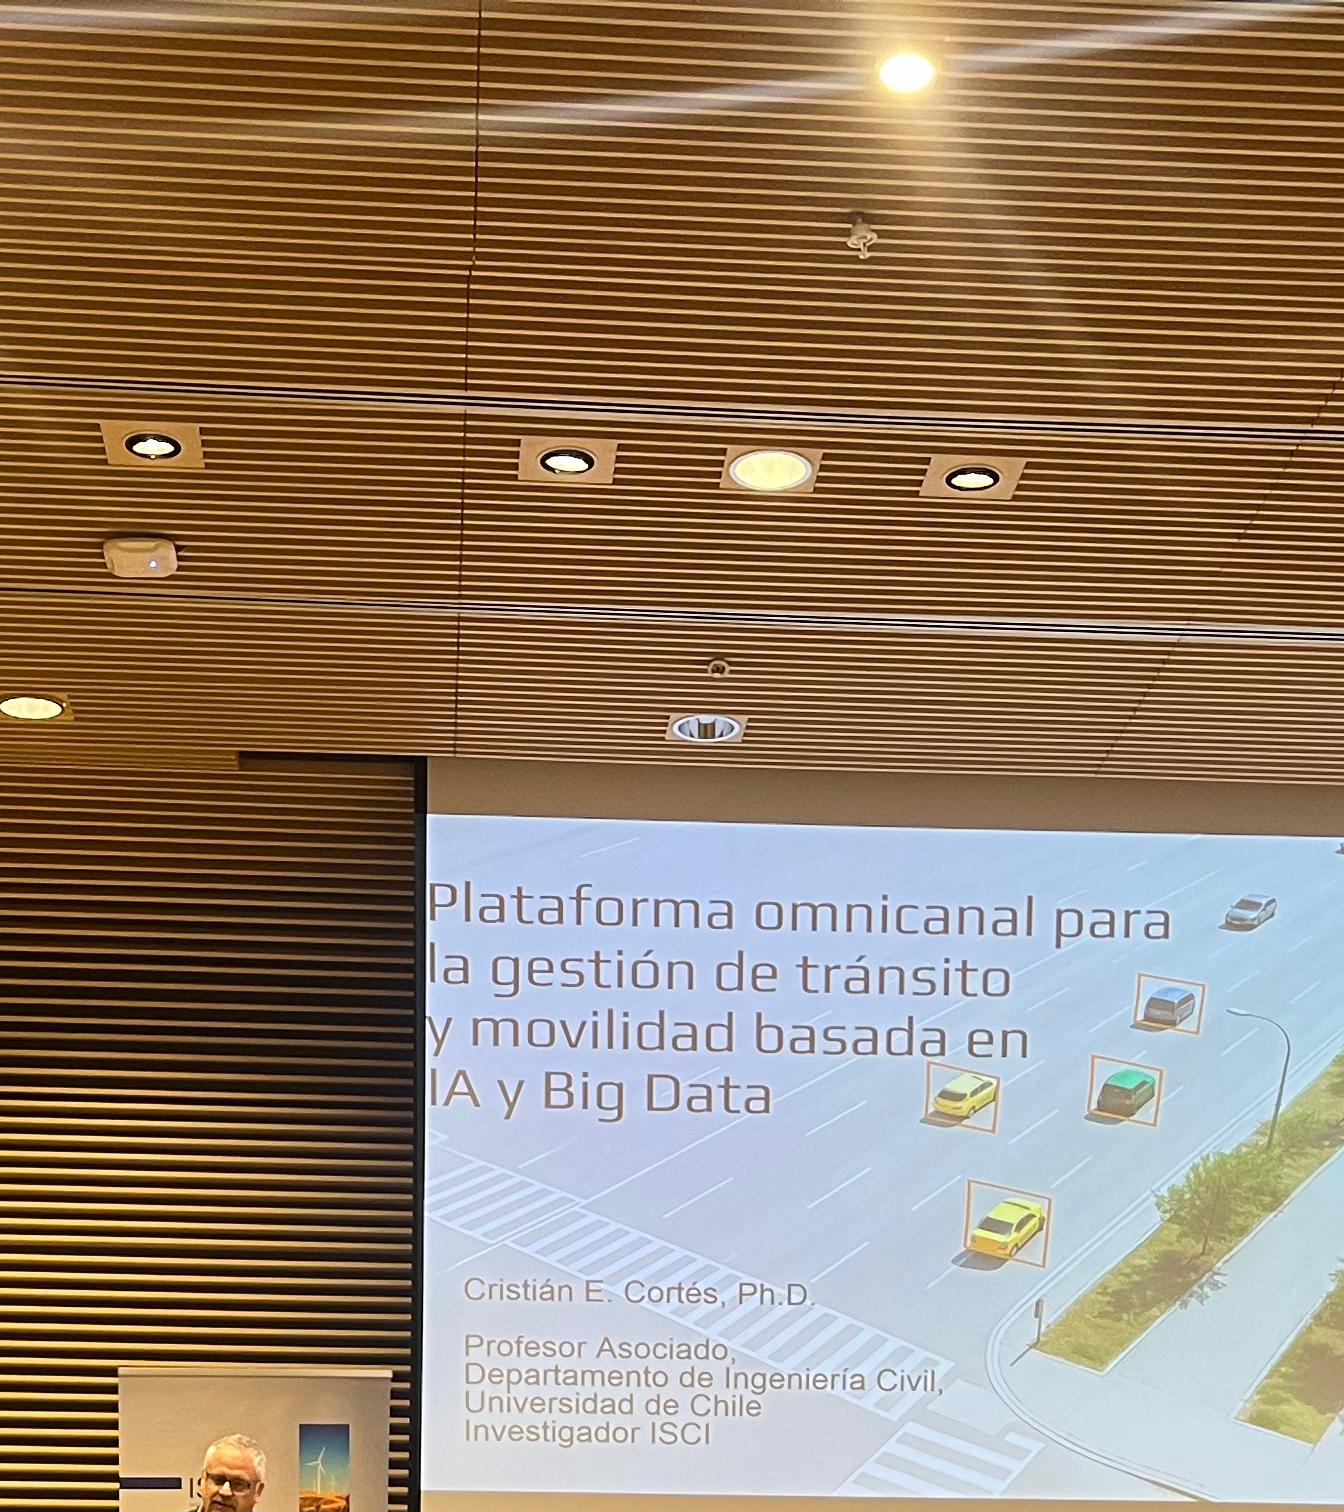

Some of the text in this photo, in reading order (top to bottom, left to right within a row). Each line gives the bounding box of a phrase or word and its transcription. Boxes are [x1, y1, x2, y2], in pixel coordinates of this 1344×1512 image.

[429, 880, 1170, 950] Plataforma omnicanal para
[429, 941, 1011, 998] la gestión de tránsito
[425, 1008, 1028, 1059] y movilidad basada en
[430, 1067, 771, 1124] IA y Big Data
[464, 1277, 816, 1309] Cristián E. Cortés, Ph.D.
[465, 1334, 736, 1366] Profesor Asociado,
[465, 1362, 944, 1396] Departamento de Ingeniería Civil,
[465, 1390, 762, 1418] Universidad de Chile
[465, 1418, 710, 1449] Investigador ISCI
